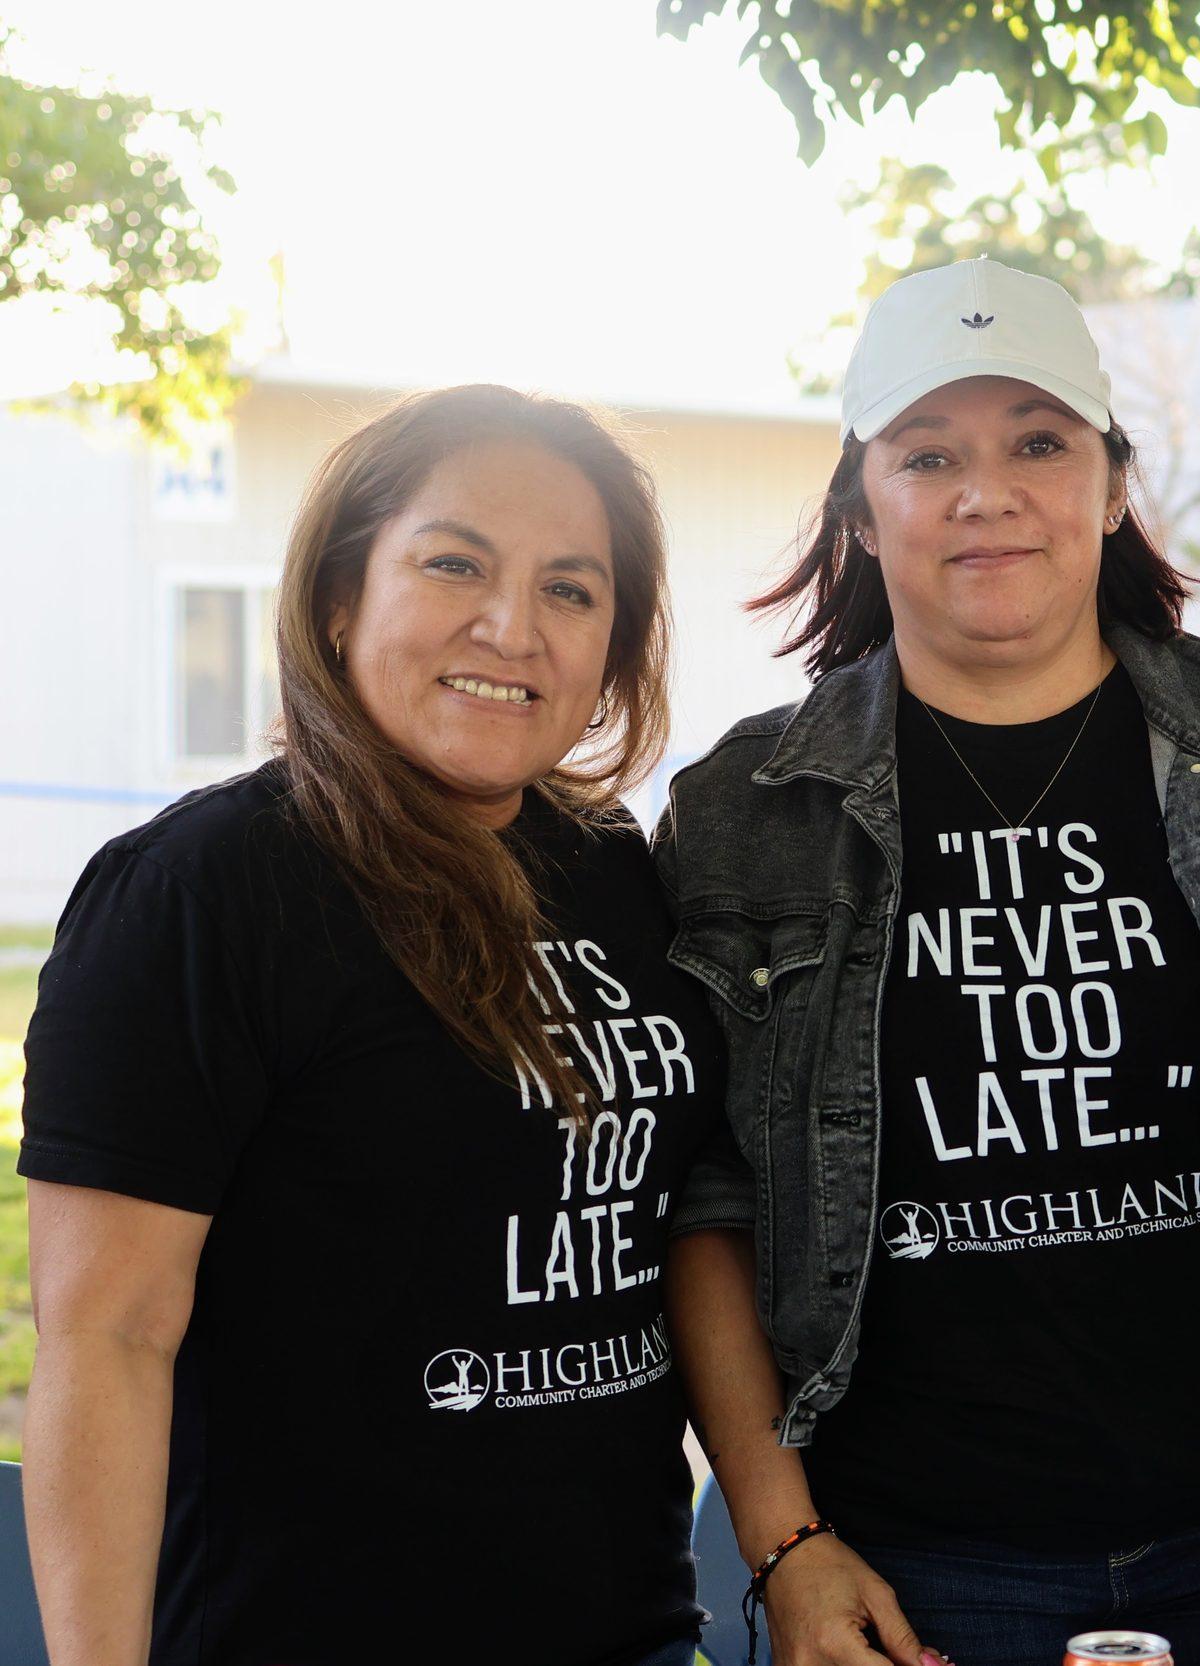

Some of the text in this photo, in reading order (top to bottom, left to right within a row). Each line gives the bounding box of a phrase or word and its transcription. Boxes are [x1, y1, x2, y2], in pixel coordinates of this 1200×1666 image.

[938, 822, 1105, 899] "IT'S
[907, 897, 1166, 977] NEVER
[961, 981, 1121, 1062] TOO
[558, 1108, 656, 1200] TOO
[947, 1237, 1026, 1252] COMMUNITY
[1028, 1230, 1094, 1248] CHARTER
[1096, 1228, 1125, 1241] AND
[1125, 1216, 1197, 1237] TECHNICAL
[493, 1312, 671, 1393] HIGHLAN
[495, 1388, 576, 1409] COMMUNITY
[579, 1380, 629, 1400] CHARTER
[629, 1373, 647, 1390] AND
